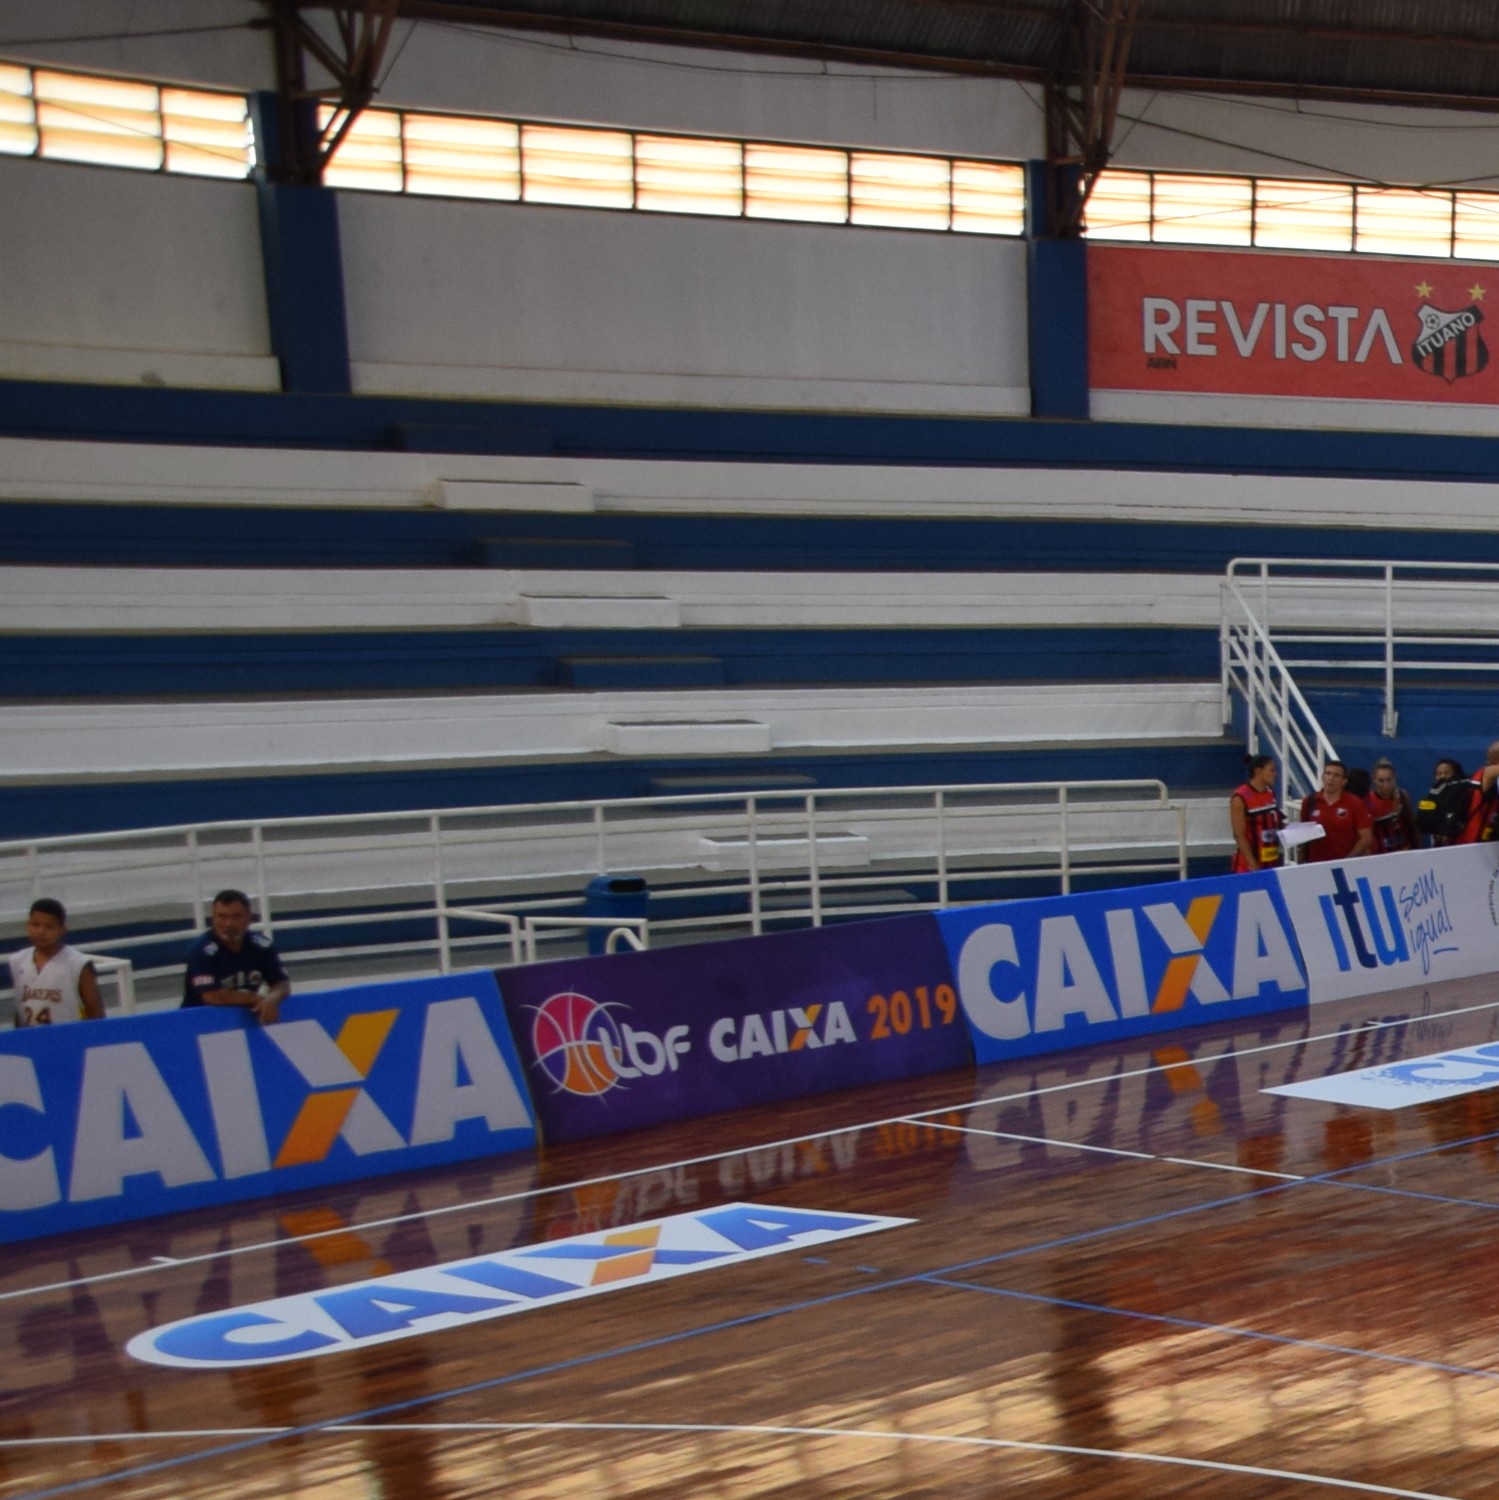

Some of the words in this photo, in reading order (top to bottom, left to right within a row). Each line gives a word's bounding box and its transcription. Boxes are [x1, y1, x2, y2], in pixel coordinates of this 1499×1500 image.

[1142, 297, 1403, 364] REVISTA
[1416, 311, 1477, 358] ITUANO
[958, 886, 1306, 1041] CAIXA
[708, 1001, 857, 1062] CAIXA
[866, 983, 957, 1041] 2019
[152, 1203, 883, 1362] CAIXA
